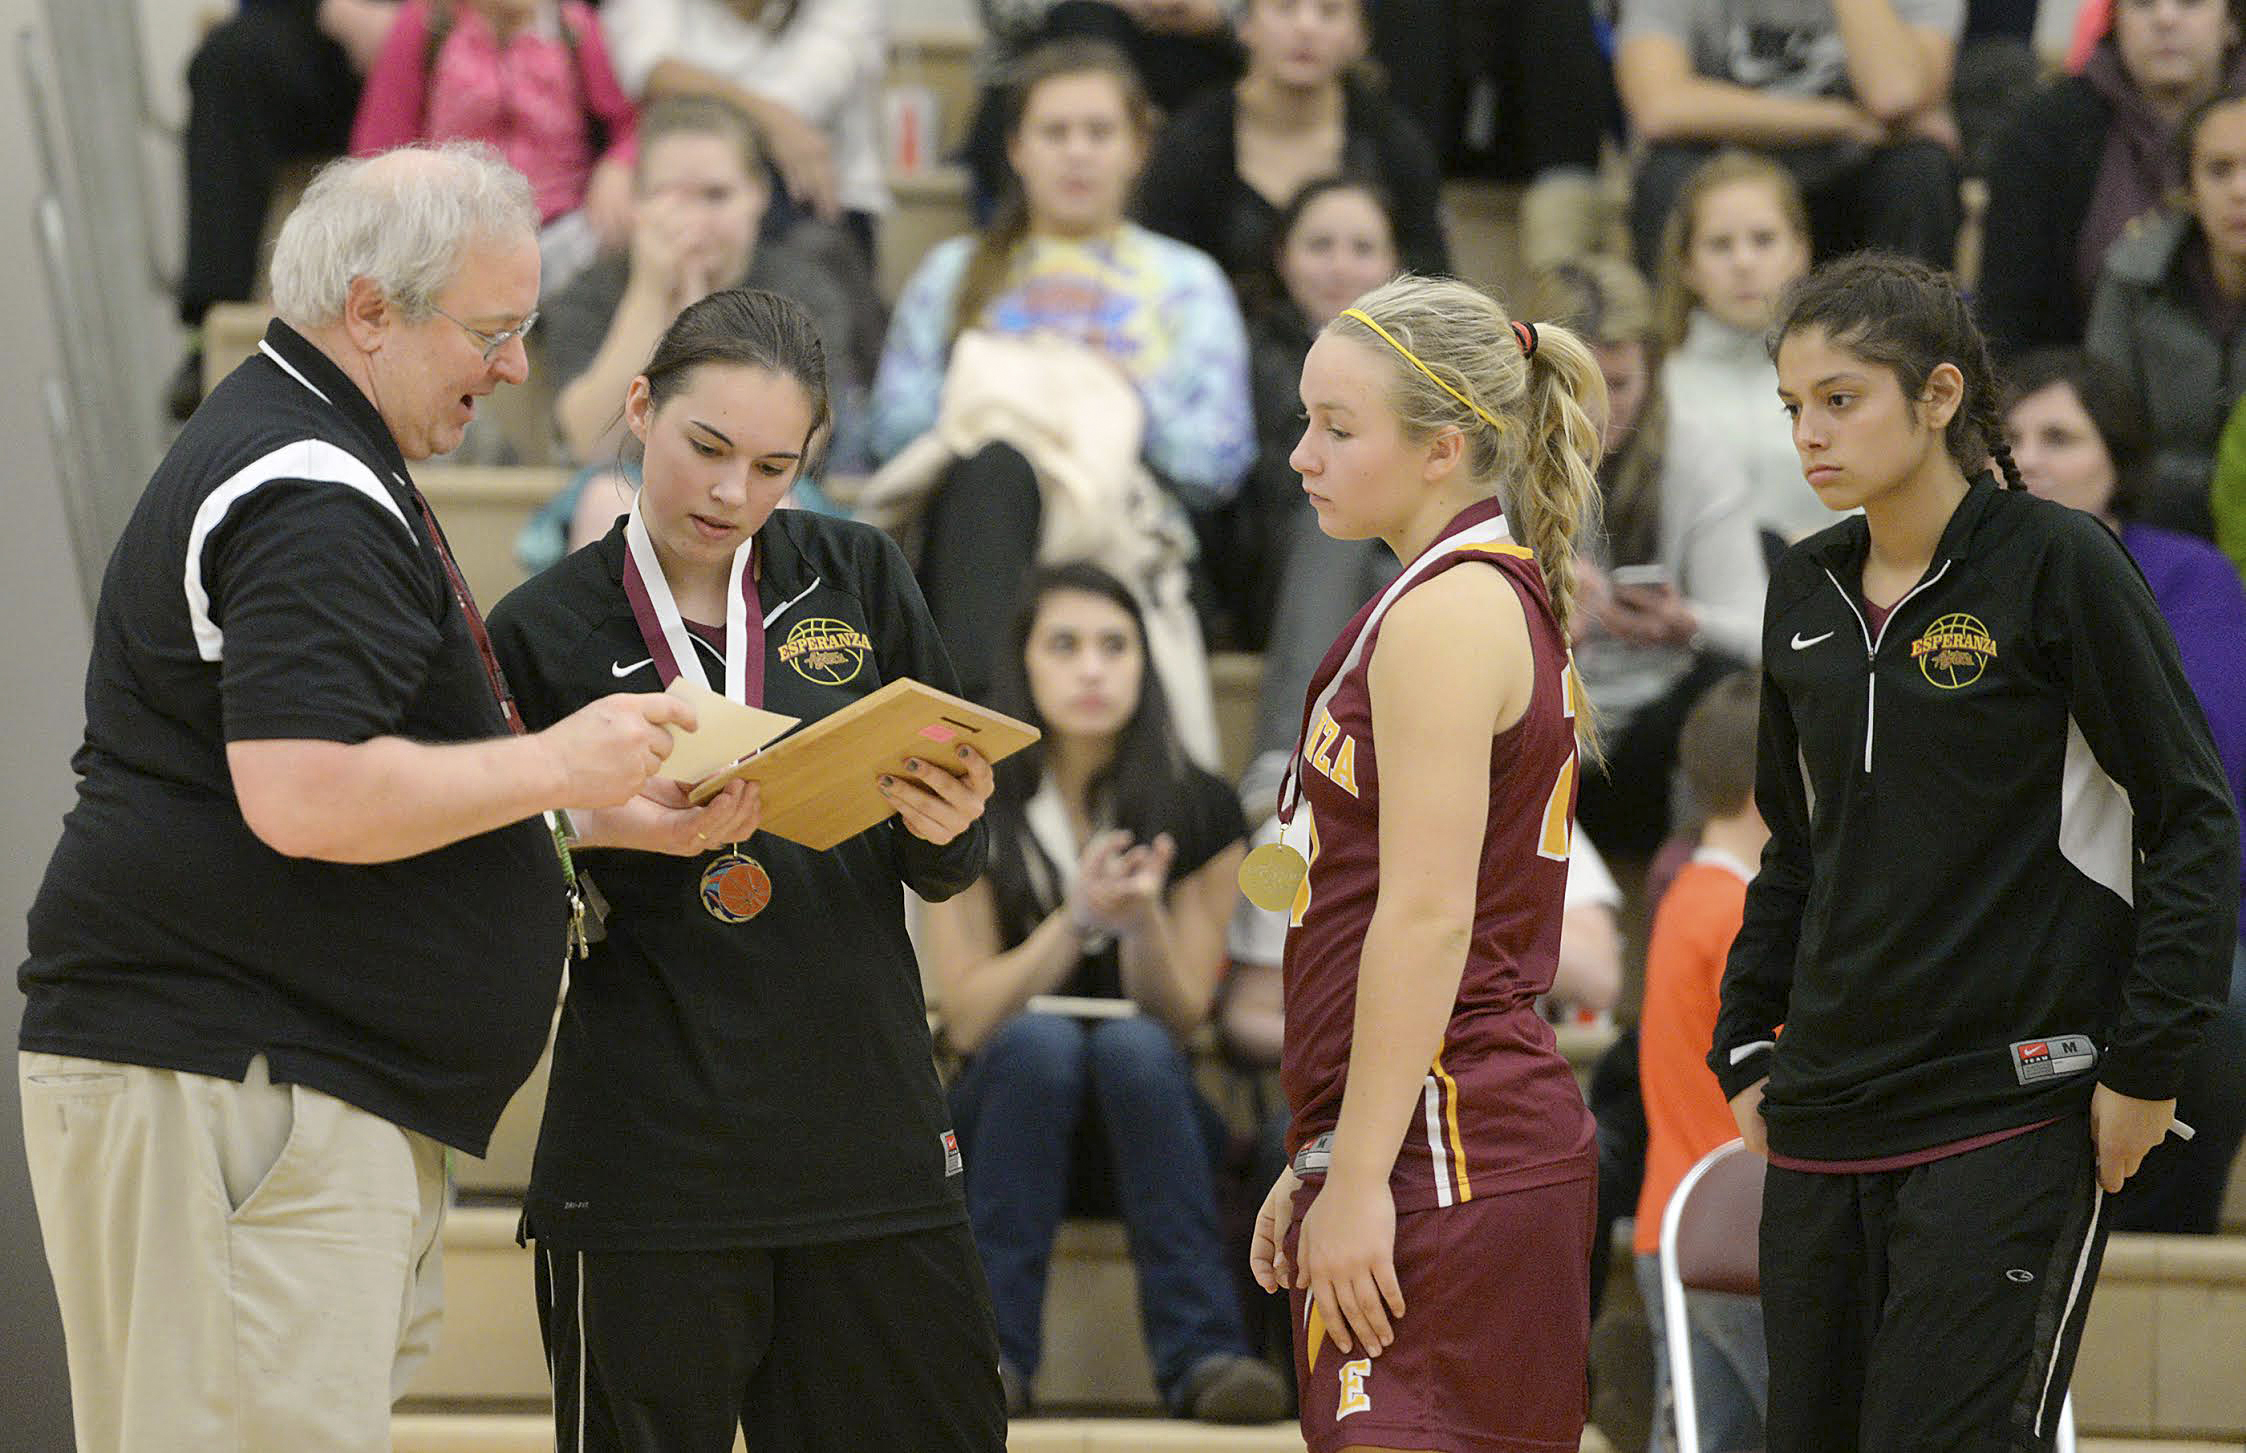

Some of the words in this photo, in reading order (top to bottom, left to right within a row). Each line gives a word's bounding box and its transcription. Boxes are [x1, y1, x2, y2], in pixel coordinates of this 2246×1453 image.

[777, 632, 872, 663] ESPERANZA
[1910, 633, 1997, 658] ESPERANZA
[2062, 1041, 2078, 1054] M
[1336, 1358, 1371, 1422] E
